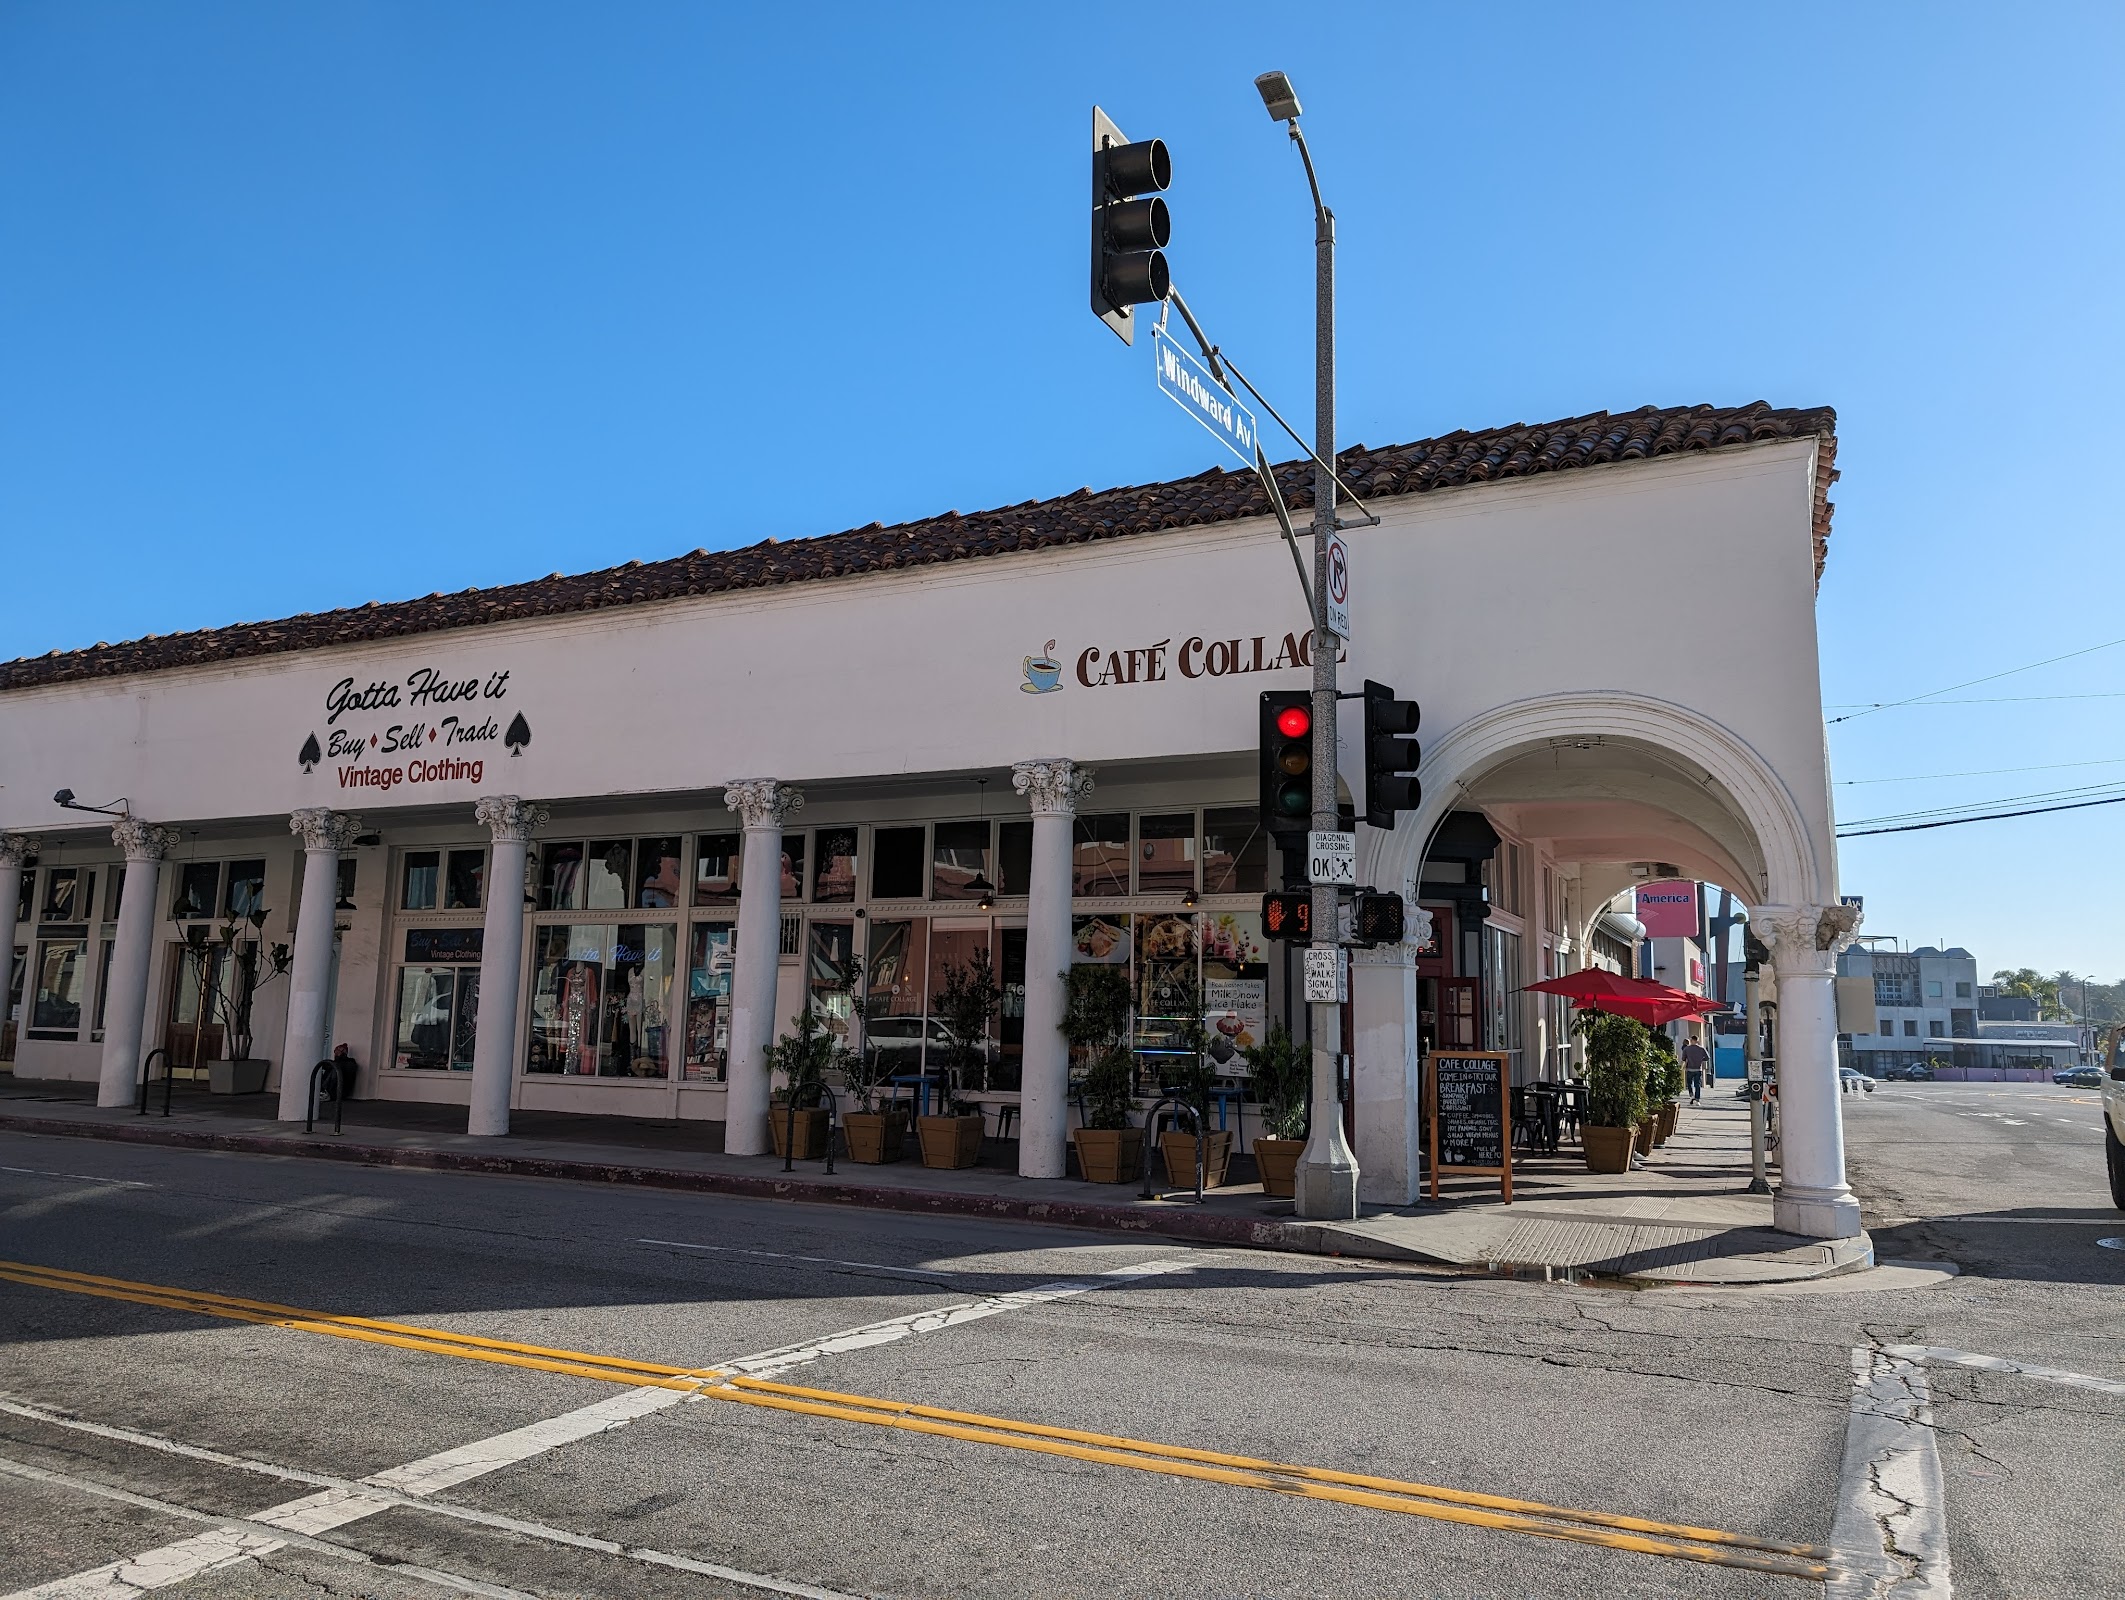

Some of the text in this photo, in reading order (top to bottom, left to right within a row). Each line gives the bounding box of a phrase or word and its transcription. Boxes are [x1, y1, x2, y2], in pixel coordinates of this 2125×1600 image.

[1162, 344, 1251, 449] Windward Av
[1329, 605, 1347, 630] ON RED
[1076, 629, 1346, 687] CAFÉ COLLA
[326, 667, 510, 725] Gotta Have it
[327, 715, 499, 762] Buy Sell Trade
[337, 757, 483, 790] Vintage Clothing
[1315, 833, 1350, 843] DIAGONAL
[1315, 841, 1350, 851] CROSSING
[1312, 857, 1330, 877] OK
[1642, 893, 1689, 904] America
[1297, 903, 1309, 932] 9
[431, 949, 481, 961] Vintage Clothing
[610, 944, 645, 962] Have
[647, 947, 662, 961] it
[1308, 951, 1333, 961] CROSS
[1316, 961, 1325, 969] ON
[1311, 969, 1332, 978] WALK
[1307, 979, 1334, 989] SIGNAL
[1211, 989, 1231, 998] Milk
[1311, 989, 1331, 999] ONLY
[1231, 999, 1257, 1009] Flake
[1439, 1059, 1497, 1071] CAFE COLLAGE
[1473, 1073, 1484, 1081] TRY
[1484, 1073, 1498, 1081] OUR
[1439, 1082, 1487, 1095] BREAKFAST
